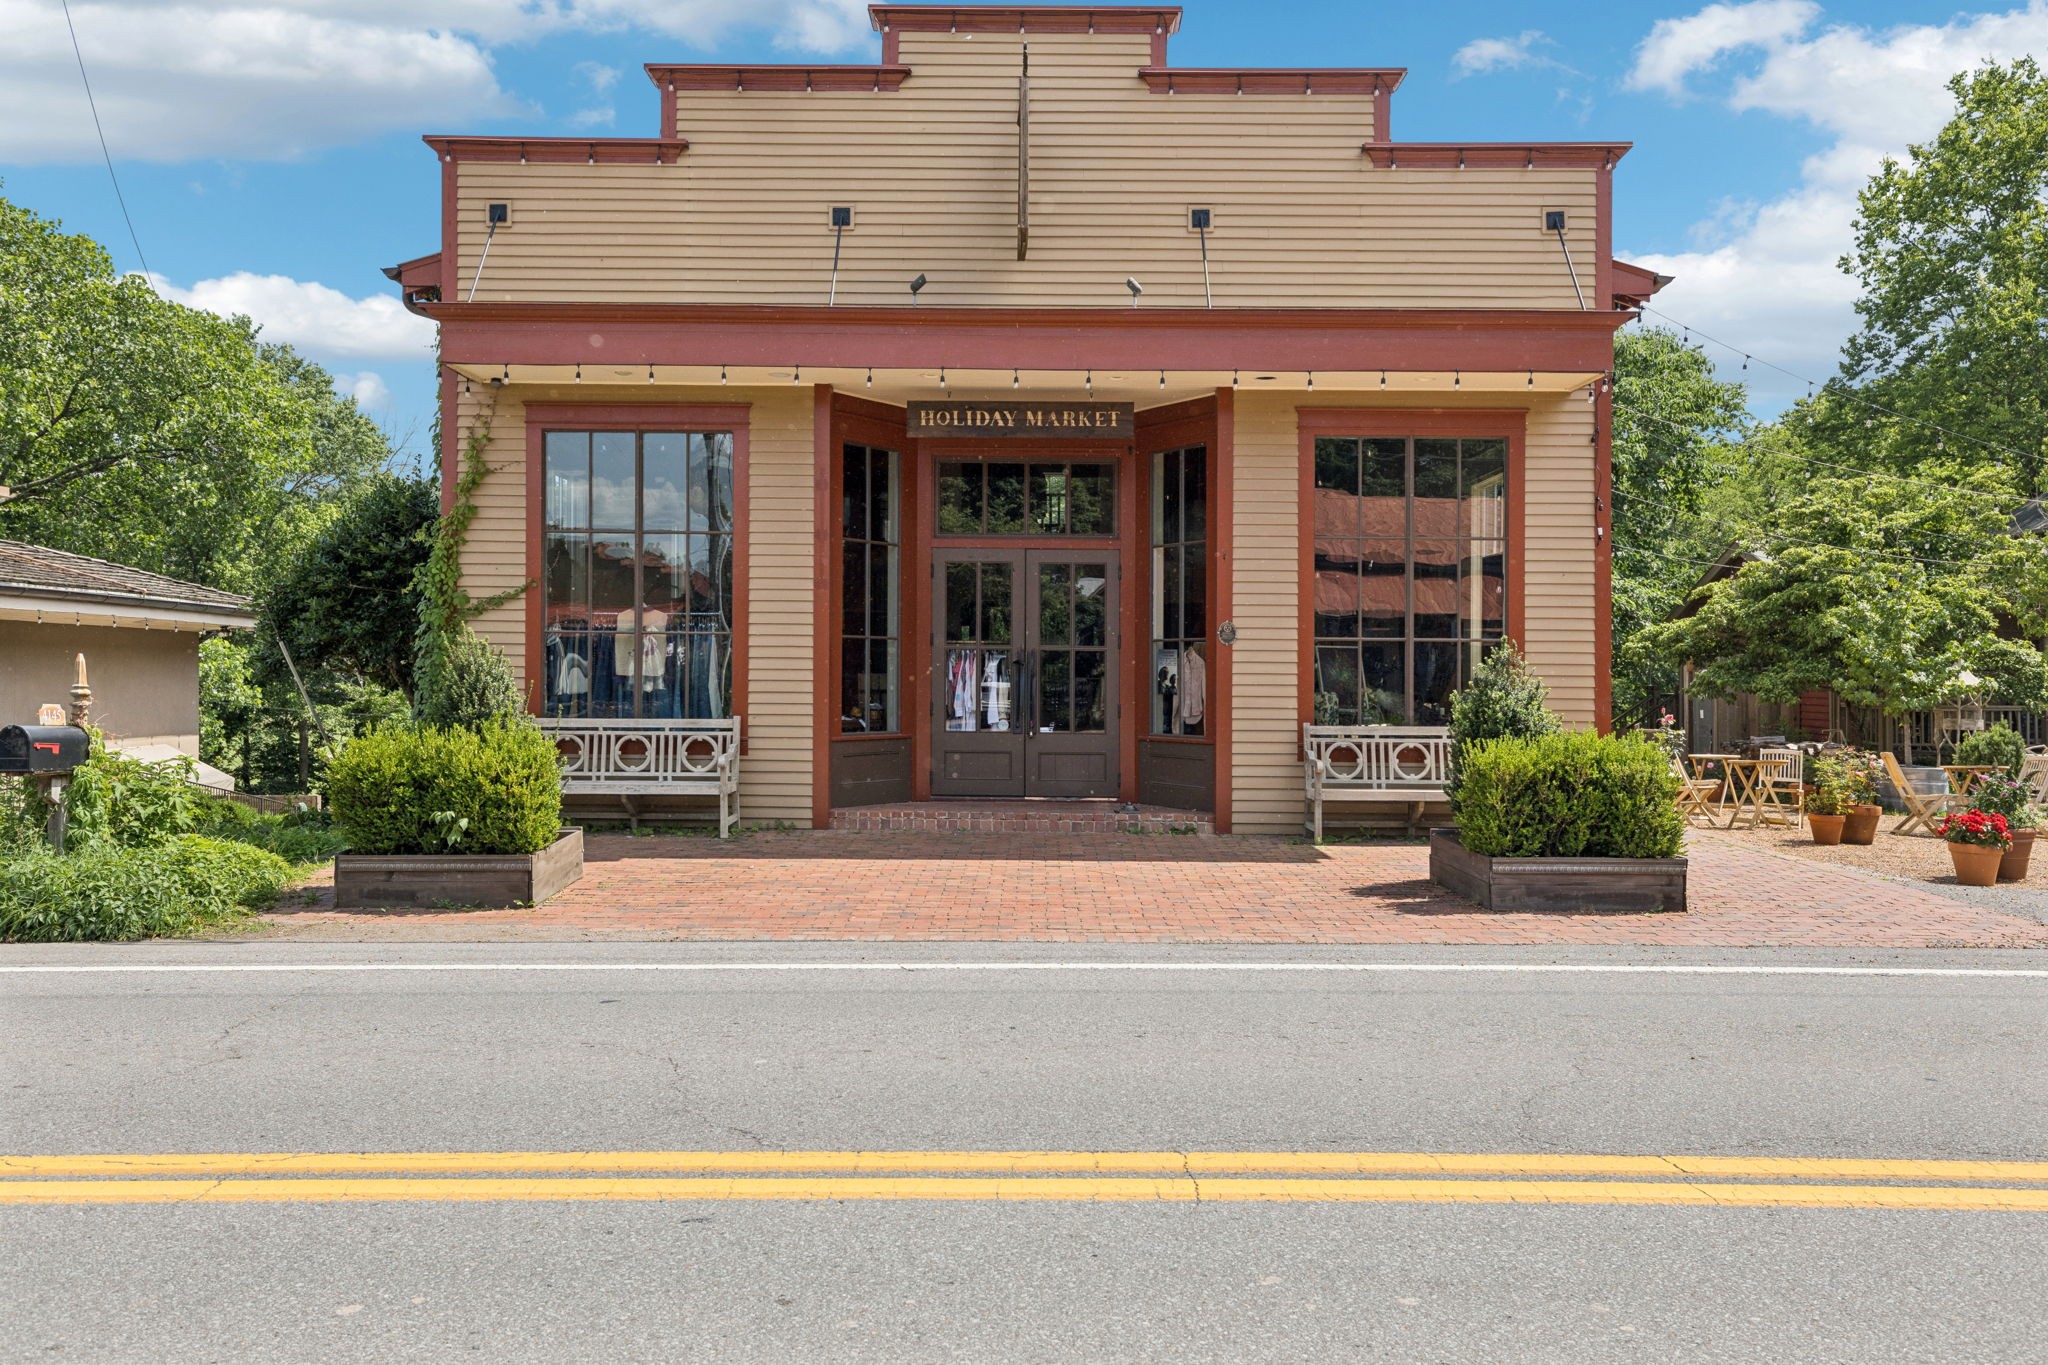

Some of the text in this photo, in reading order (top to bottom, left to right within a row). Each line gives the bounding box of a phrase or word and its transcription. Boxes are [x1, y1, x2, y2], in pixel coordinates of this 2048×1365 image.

[920, 410, 1120, 427] HOLIDAY MARKET
[42, 709, 62, 722] 4145
